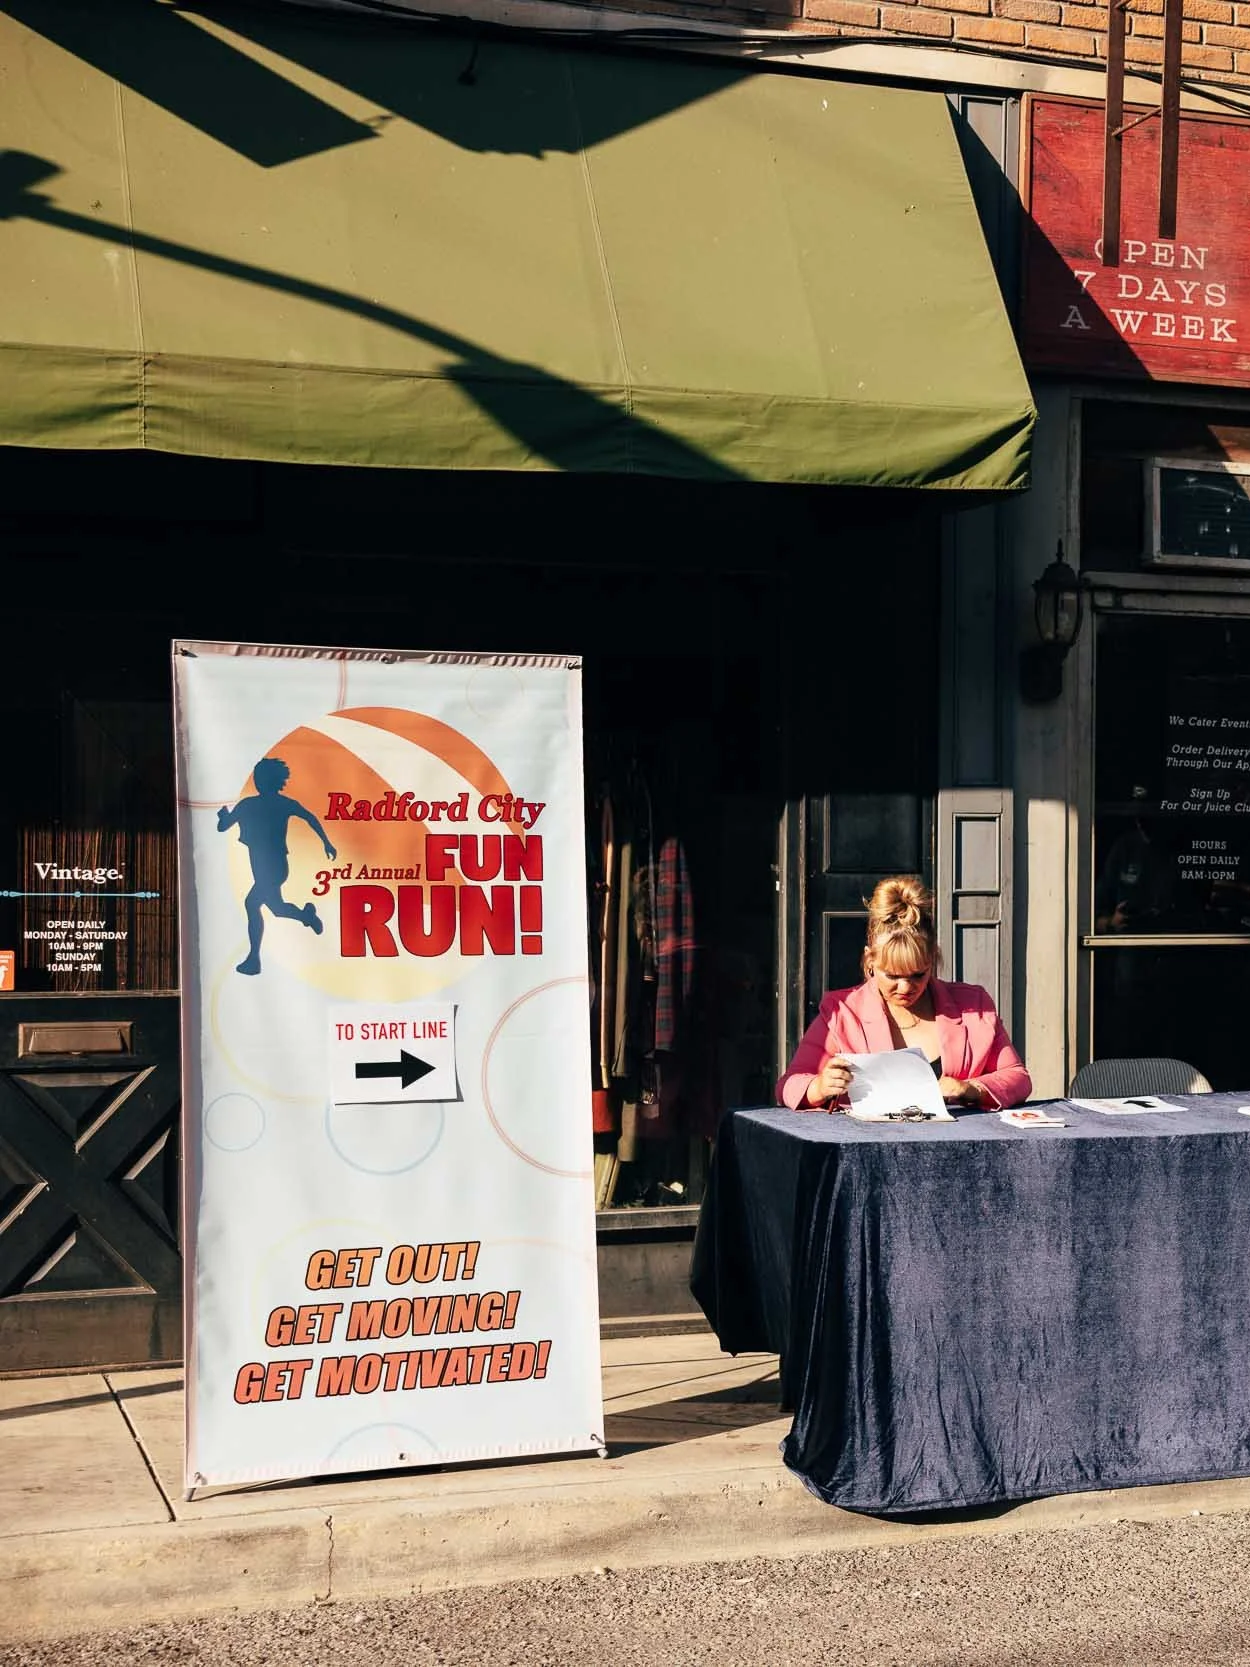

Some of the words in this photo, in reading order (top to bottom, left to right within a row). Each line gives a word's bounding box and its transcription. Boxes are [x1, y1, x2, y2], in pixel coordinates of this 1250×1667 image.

[1074, 270, 1096, 293] 7
[1118, 274, 1226, 307] DAYS
[1060, 306, 1090, 329] A
[1110, 309, 1237, 342] WEEK
[1169, 716, 1184, 726] We
[1188, 717, 1217, 727] Cater
[1172, 744, 1203, 755] Order
[1207, 745, 1250, 758] Delivery
[1166, 757, 1209, 769] Through
[1213, 759, 1232, 769] Our
[1190, 788, 1212, 800] Sign
[1216, 789, 1230, 800] Up
[325, 792, 468, 822] Radford
[477, 794, 546, 828] City
[1160, 800, 1179, 810] For
[1182, 801, 1201, 811] Our
[1204, 802, 1231, 813] Juice
[1192, 840, 1227, 850] HOURS
[312, 864, 351, 896] 3rd
[355, 864, 421, 881] Annual
[425, 834, 544, 882] FUN
[1177, 855, 1207, 865] OPEN
[1210, 855, 1240, 865] DAILY
[34, 862, 124, 884] Vintage.
[46, 920, 75, 929] OPEN
[77, 920, 106, 929] DAILY
[340, 885, 544, 957] RUN!
[24, 931, 67, 939] MONDAY
[75, 931, 128, 939] SATURDAY
[48, 942, 75, 950] 10AM
[83, 942, 104, 950] 9PM
[55, 952, 96, 961] SUNDAY
[46, 964, 73, 972] 10AM
[80, 964, 102, 972] 5PM
[335, 1024, 355, 1041] TO
[361, 1023, 407, 1041] START
[412, 1021, 449, 1039] LINE
[305, 1247, 383, 1291] GET
[386, 1241, 481, 1285] OUT!
[265, 1303, 344, 1348] GET
[346, 1291, 521, 1341] MOVING!
[233, 1359, 314, 1405] GET
[315, 1340, 552, 1398] MOTIVATED!
